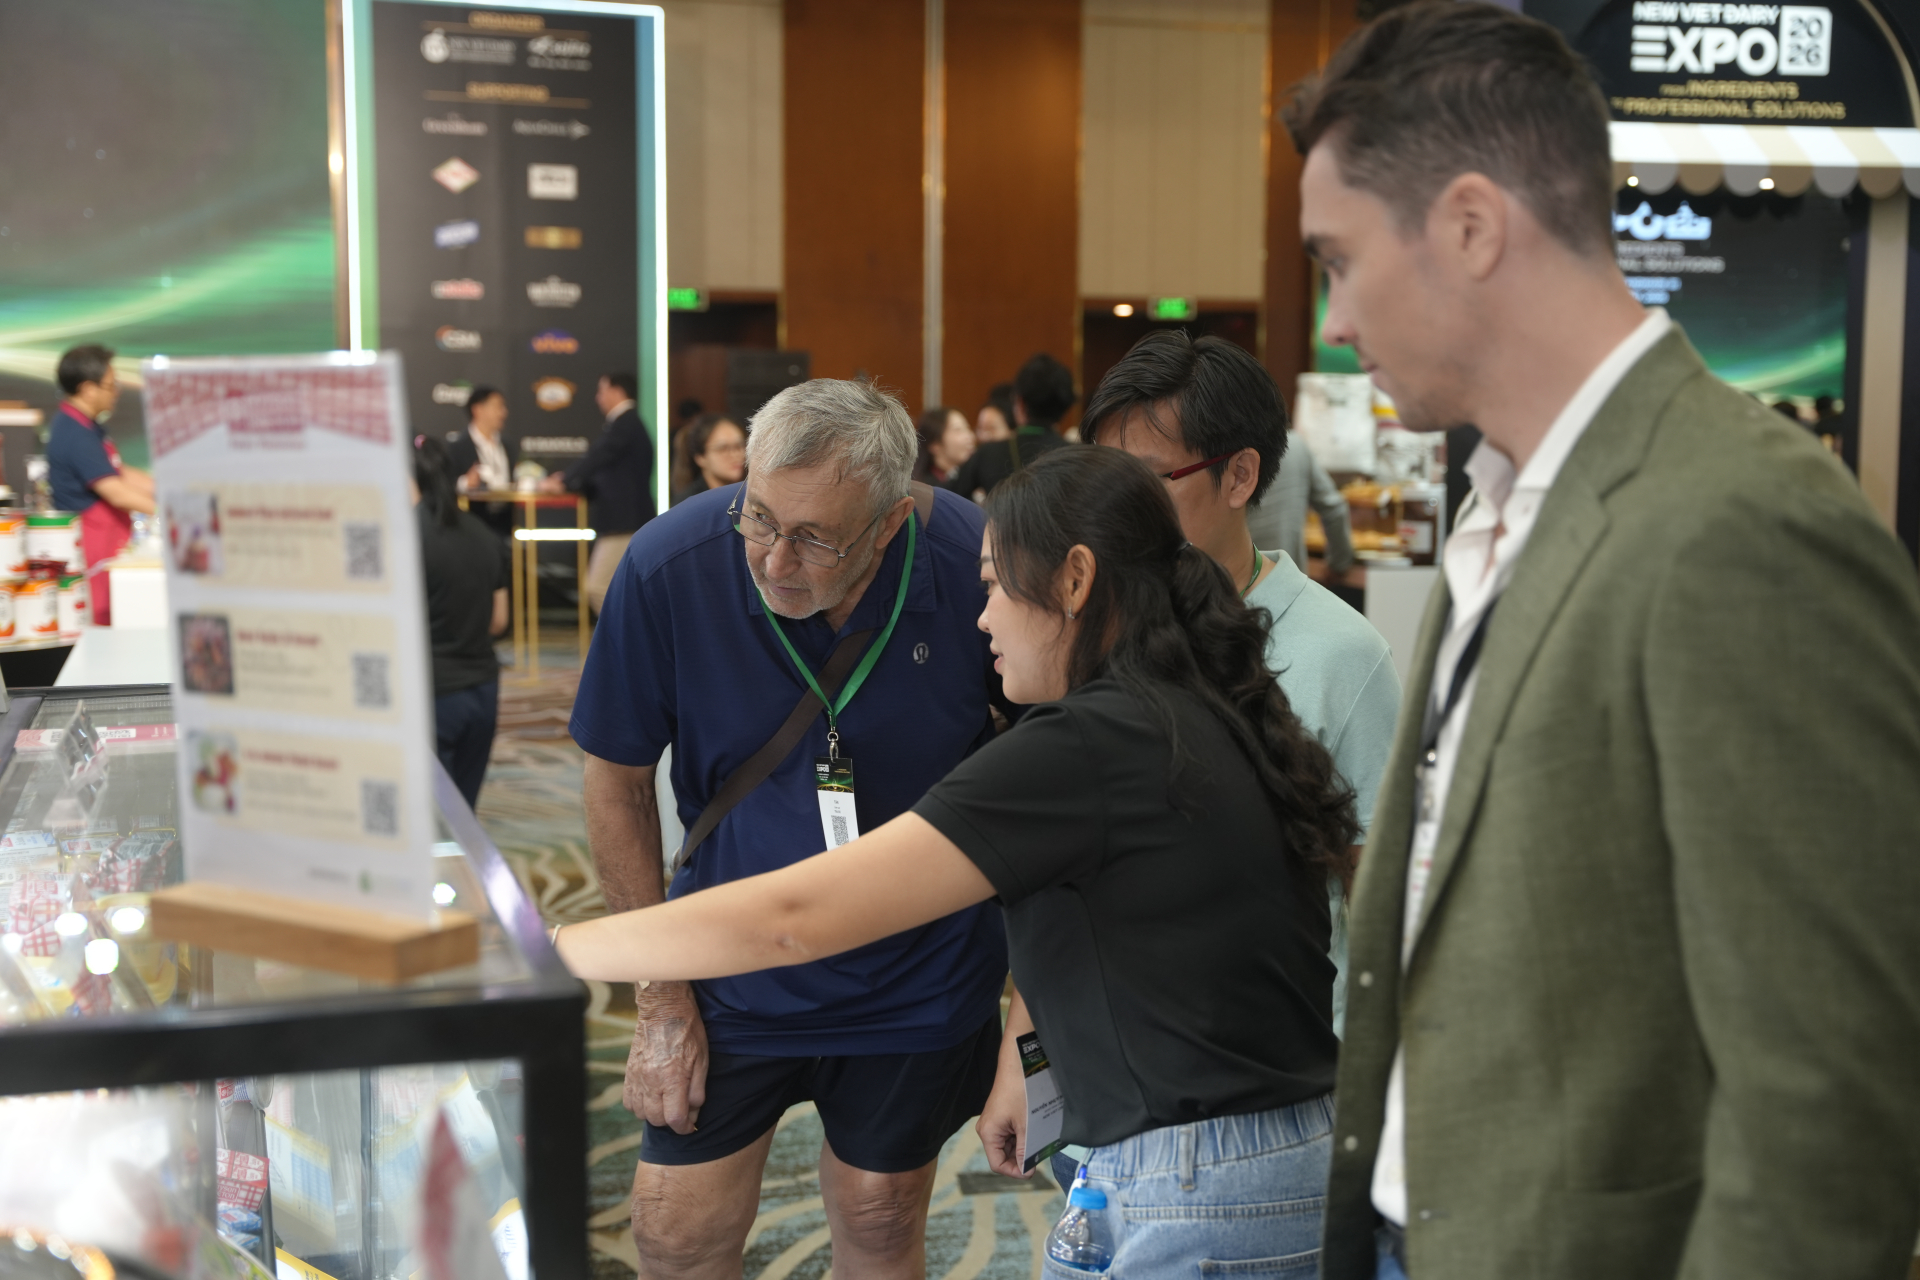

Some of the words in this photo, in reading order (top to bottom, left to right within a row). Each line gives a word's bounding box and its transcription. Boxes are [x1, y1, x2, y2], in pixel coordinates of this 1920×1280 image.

[1632, 1, 1679, 22] NEW
[1680, 2, 1721, 24] VIET
[1722, 3, 1780, 25] DAIRY
[1789, 16, 1823, 39] 20
[1630, 25, 1779, 76] EXPO
[1788, 43, 1821, 67] 26
[1687, 80, 1799, 99] INGREDIENTS
[1623, 97, 1750, 118] PROFESSIONAL
[1752, 101, 1846, 119] SOLUTIONS
